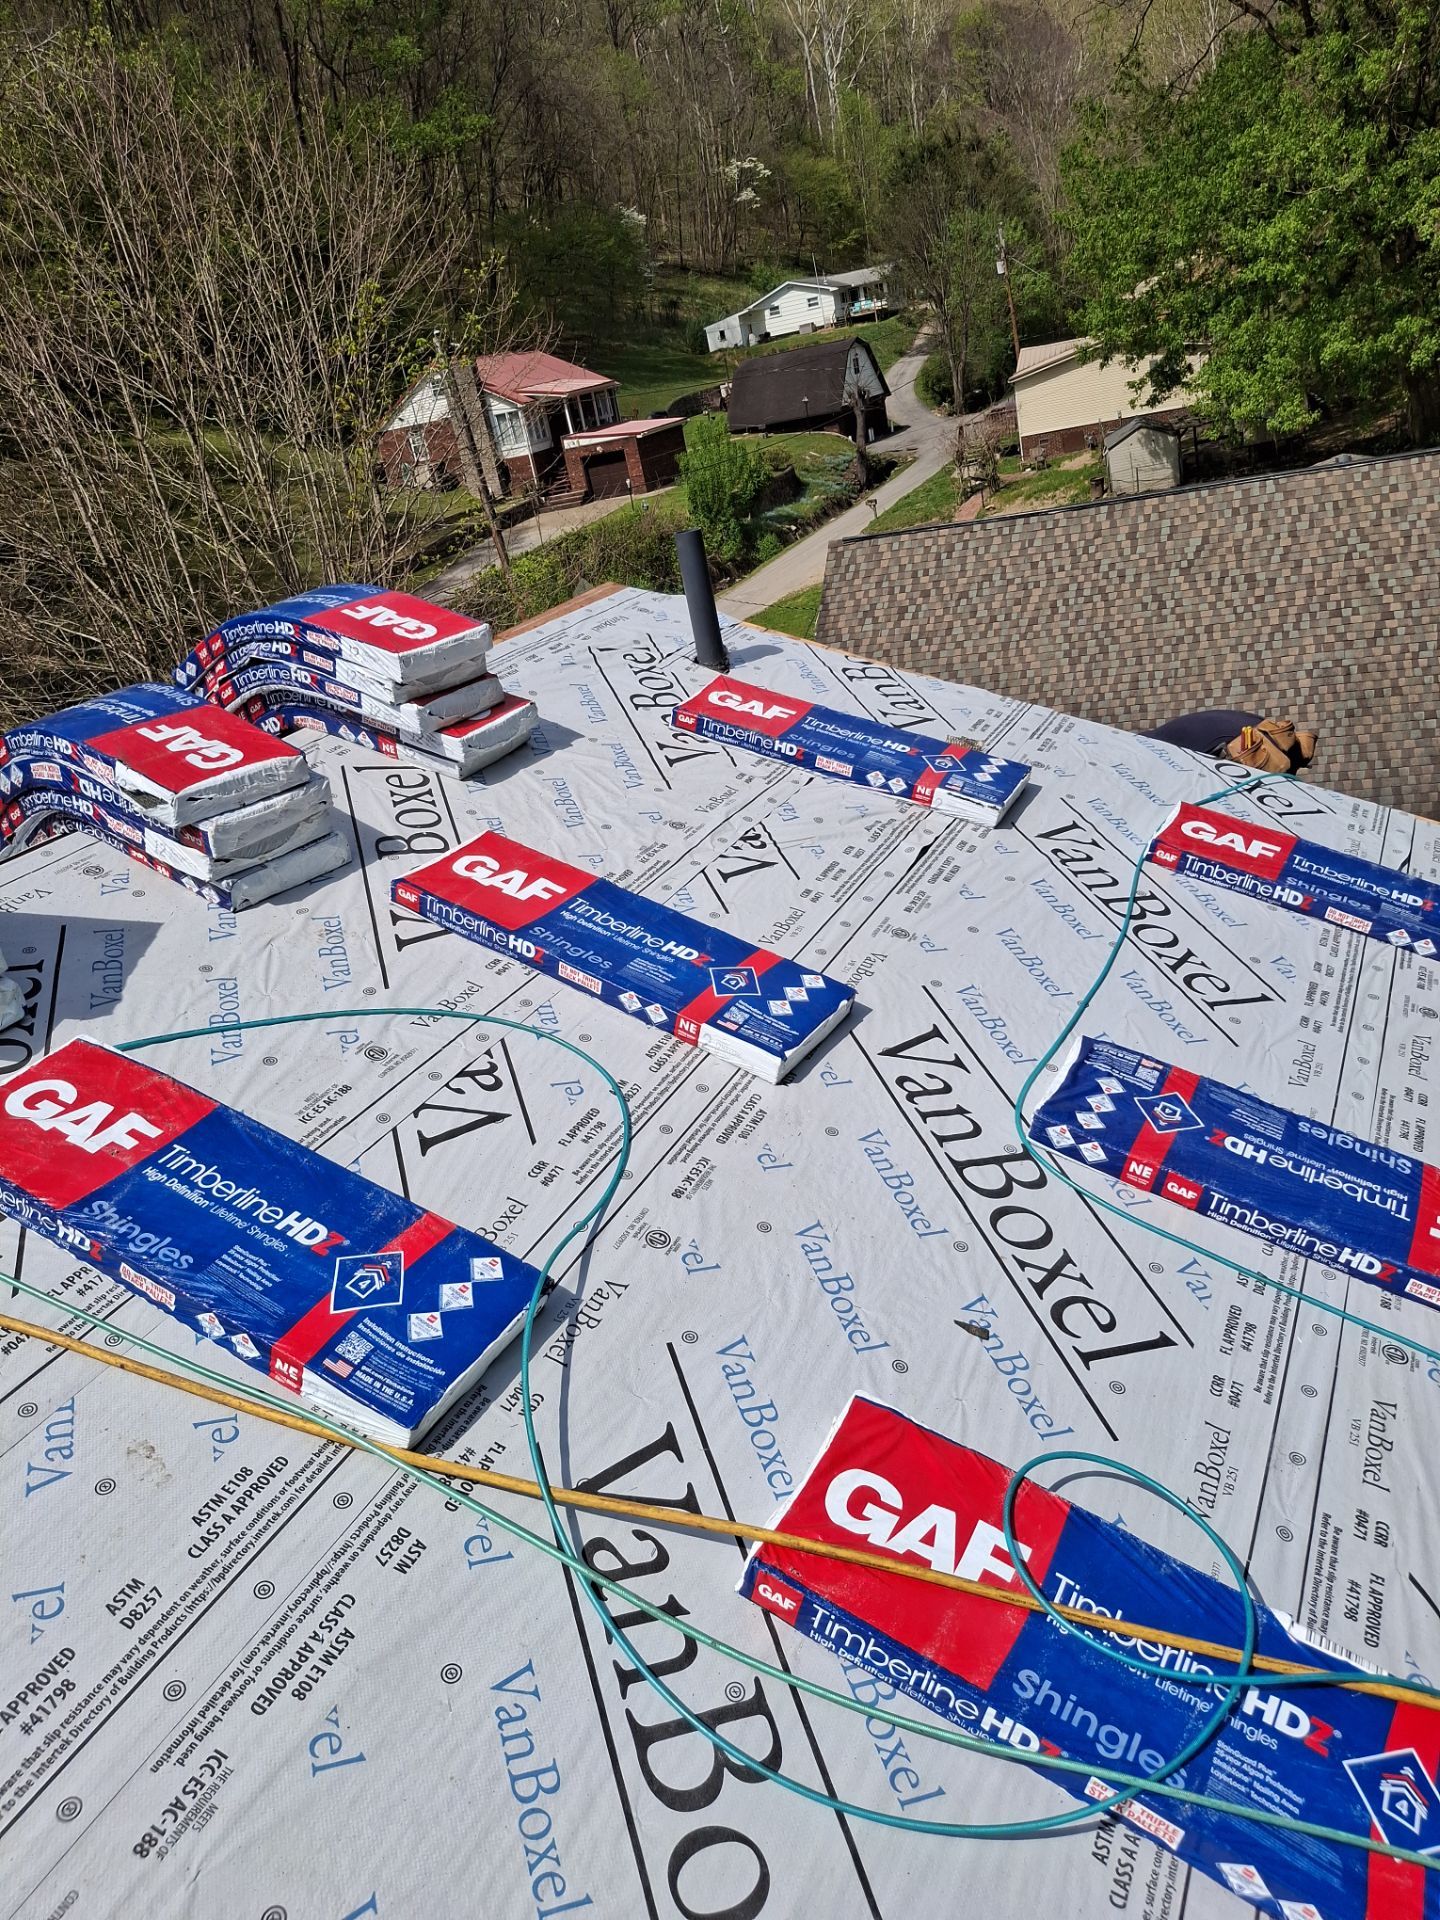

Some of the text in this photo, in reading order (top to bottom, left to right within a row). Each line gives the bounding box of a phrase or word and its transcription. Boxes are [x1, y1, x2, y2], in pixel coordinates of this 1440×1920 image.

[340, 604, 438, 641] GAF
[677, 712, 697, 726] GAF
[706, 690, 797, 722] GAF
[135, 723, 245, 770] GAF
[381, 743, 396, 755] NE
[915, 784, 932, 796] NE
[1154, 848, 1178, 864] GAF
[1180, 819, 1281, 858] GAF
[394, 887, 419, 906] GAF
[450, 853, 567, 901] GAF
[1283, 875, 1373, 912] Shingles
[757, 905, 807, 946] VanBoxel
[1028, 877, 1104, 943] VanBoxel
[1033, 819, 1277, 1012] VanBoxel
[90, 926, 125, 1011] VanBoxel
[311, 913, 353, 992] VanBoxel
[528, 925, 614, 969] Shingles
[994, 926, 1074, 1000] VanBoxel
[204, 975, 244, 1067] VanBoxel
[677, 1016, 700, 1036] NE
[955, 983, 1038, 1066] VanBoxel
[1118, 968, 1209, 1047] VanBoxel
[1288, 1039, 1318, 1089] VanBoxel
[1407, 1034, 1433, 1082] VanBoxel
[7, 1079, 164, 1154] GAF
[565, 1104, 601, 1141] APPROVED
[579, 1117, 607, 1146] #41798
[713, 1090, 762, 1149] CLASS APPROVED
[736, 1106, 767, 1143] ASTM E108
[526, 1157, 550, 1182] CCRR
[1127, 1159, 1154, 1180] NE
[1298, 1120, 1412, 1176] Shingles
[540, 1162, 565, 1189] #0471
[668, 1153, 711, 1203] ICC-ES AC-188
[856, 1127, 950, 1241] VanBoxel
[876, 1022, 1179, 1372] VanBoxel
[1165, 1177, 1199, 1203] GAF
[83, 1197, 198, 1271] Shingles
[142, 1165, 288, 1254] High Shingles
[794, 1218, 891, 1356] VanBoxel
[542, 1278, 631, 1369] VanBoxel
[1218, 1303, 1243, 1357] FL APPROVED
[1239, 1320, 1258, 1353] #41798
[274, 1356, 300, 1381] NE
[352, 1367, 376, 1386] MADE
[958, 1292, 1076, 1443] VanBoxel
[1208, 1373, 1226, 1397] CCRR
[462, 1403, 482, 1426] aware
[714, 1333, 795, 1504] VanBoxel
[1225, 1379, 1246, 1408] #0471
[1348, 1417, 1362, 1448] VB 251
[1360, 1397, 1398, 1494] VanBoxel
[189, 1461, 256, 1530] ASTM E108
[1183, 1420, 1232, 1523] VanBoxel
[1222, 1464, 1241, 1499] VB 251
[184, 1518, 227, 1563] CLASS
[228, 1451, 291, 1518] APPROVED
[823, 1468, 1032, 1582] GAF
[1351, 1507, 1371, 1542] #0471
[372, 1523, 412, 1569] D8257
[392, 1536, 428, 1578] ASTM
[1371, 1520, 1390, 1549] CCRR
[1306, 1511, 1332, 1609] Refer the Intertek Directory
[39, 1724, 65, 1751] slip
[56, 1678, 106, 1733] resistance
[98, 1660, 126, 1689] may
[115, 1640, 144, 1669] vary
[132, 1595, 183, 1649] dependent
[185, 1552, 226, 1595] weather,
[217, 1527, 249, 1561] surface
[241, 1491, 282, 1534] conditions
[282, 1452, 318, 1490] footwear
[102, 1572, 147, 1619] ASTM
[116, 1581, 167, 1634] D8257
[755, 1579, 797, 1613] GAF
[1317, 1535, 1340, 1636] aware that slip resistance may
[1341, 1578, 1363, 1623] #41798
[1360, 1572, 1386, 1648] FL APPROVED
[11, 1452, 334, 1800] the Intertek Directory of Building Products for detailed
[147, 1476, 405, 1779] Building Products for detailed information
[170, 1478, 419, 1772] may vary dependent weather, surface conditions footwear being used.
[315, 1588, 358, 1637] CLASS
[288, 1624, 356, 1705] ASTM E108
[809, 1629, 836, 1654] High
[0, 1638, 80, 1731] APPROVED
[247, 1637, 316, 1721] APPROVED
[15, 1672, 79, 1741] #41798
[1011, 1667, 1188, 1791] Shingles
[129, 1743, 230, 1864] ICC-ES AC-188
[162, 1763, 235, 1850] THE REQUIREMENTS
[489, 1657, 594, 1920] VanBoxel
[189, 1800, 220, 1835] MEETS
[1086, 1817, 1121, 1866] ASTM
[1122, 1807, 1179, 1844] PALLETS
[1136, 1806, 1186, 1839] TRIPLE
[1101, 1855, 1141, 1911] CLASS
